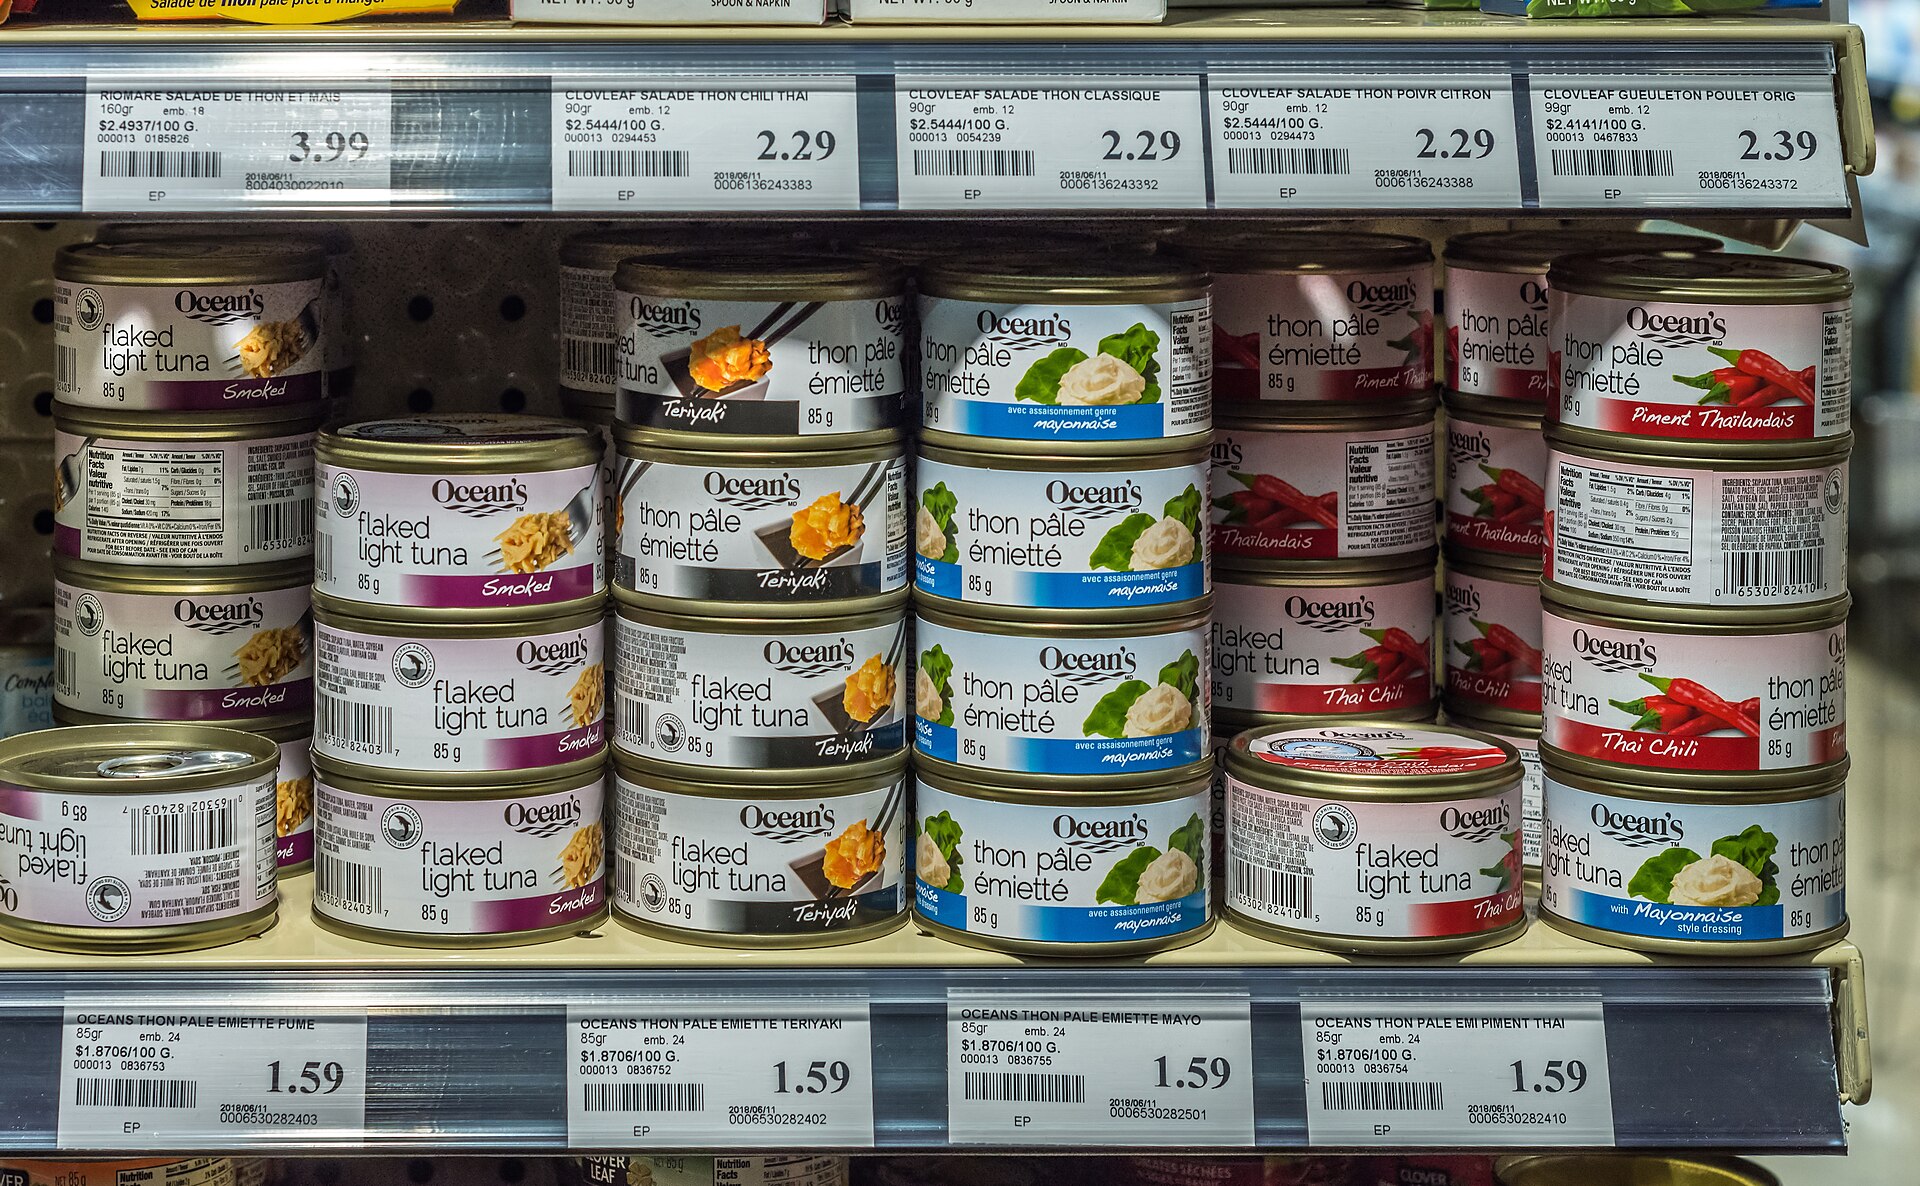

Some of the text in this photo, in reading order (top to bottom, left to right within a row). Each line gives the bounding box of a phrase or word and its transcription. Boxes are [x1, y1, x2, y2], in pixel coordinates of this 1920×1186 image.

[100, 91, 162, 100] RIOMARE
[166, 91, 220, 101] SALADE
[224, 91, 243, 101] DE
[246, 92, 284, 102] THON
[288, 92, 305, 101] ET
[565, 90, 808, 101] CLOVLEAF SALADE THON CHILI THAI
[909, 89, 1160, 101] CLOVLEAF SALADE THON CLASSIQUE
[1222, 89, 1491, 99] CLOVLEAF SALADE THON POIVR CITRON
[1544, 89, 1796, 101] CLOVLEAF GUEULETON POULET ORIG
[100, 120, 198, 131] $2.4937/100 G.
[566, 119, 664, 130] $2.5444/100 G.
[910, 119, 1009, 130] $2.5444/100 G.
[1224, 117, 1323, 128] $2.5444/100 G.
[1547, 119, 1645, 130] $2.4141/100 G.
[289, 132, 369, 163] 3.99
[757, 130, 835, 161] 2.29
[1102, 130, 1180, 161] 2.29
[1416, 129, 1494, 159] 2.29
[1739, 130, 1817, 161] 2.39
[714, 180, 812, 190] 0006136243383
[1375, 177, 1473, 188] 0006136243388
[1700, 179, 1797, 189] 0006136243372
[175, 288, 264, 312] Ocean's
[1347, 276, 1416, 304] Ocean's
[631, 296, 701, 330] Ocean's
[1627, 307, 1726, 337] Ocean's
[103, 323, 173, 348] flaked
[1268, 312, 1379, 342] thon pâle
[808, 338, 895, 370] thon pâle
[1269, 343, 1361, 365] émietté
[1564, 334, 1664, 369] thon pâle
[104, 349, 209, 376] light tuna
[103, 382, 124, 401] 85 g
[223, 380, 286, 399] Smoked
[809, 372, 884, 396] émietté
[1565, 367, 1640, 396] émietté
[663, 400, 727, 425] Teriyaki
[1632, 407, 1794, 428] Piment Thaïlandais
[432, 478, 527, 504] Ocean's
[1046, 479, 1142, 506] Ocean's
[358, 511, 429, 540] flaked
[969, 508, 1085, 542] thon pâle
[360, 539, 467, 568] light tuna
[969, 539, 1061, 567] émietté
[1593, 556, 1612, 565] REVERSE
[1616, 560, 1634, 568] VALEUR
[1635, 562, 1662, 572] NUTRITIVE
[359, 574, 379, 595] 85 g
[482, 576, 552, 596] Smoked
[969, 575, 991, 596] 85 g
[1103, 571, 1160, 582] assaisonnement
[1161, 571, 1177, 580] genre
[1108, 580, 1177, 600] mayonnaise
[1738, 582, 1815, 597] 65302 82410
[1285, 595, 1374, 620] Ocean's
[1324, 685, 1402, 705] Thai Chili
[740, 803, 835, 832] Ocean's
[1440, 798, 1510, 830] Ocean's
[672, 836, 747, 866] flaked
[1356, 843, 1438, 868] flaked
[673, 863, 786, 893] light tuna
[1358, 869, 1471, 900] light tuna
[1611, 902, 1742, 925] with Mayonnaise
[1678, 923, 1741, 935] style dressing
[76, 1014, 314, 1030] OCEANS THON PALE EMIETTE FUME
[580, 1018, 842, 1029] OCEANS THON PALE EMIETTE TERIYAKI
[961, 1009, 1202, 1026] OCEANS THON PALE EMIETTE MAYO
[1315, 1018, 1565, 1028] OCEANS THON PALE EMI PIMENT THAI
[76, 1045, 174, 1058] $1.8706/100 G.
[581, 1050, 679, 1063] $1.8706/100 G.
[962, 1039, 1060, 1053] $1.8706/100 G.
[1317, 1049, 1416, 1061] $1.8706/100 G.
[267, 1061, 343, 1094] 1.59
[773, 1061, 849, 1093] 1.59
[1154, 1056, 1230, 1089] 1.59
[1510, 1060, 1587, 1092] 1.59
[220, 1113, 317, 1125] 0006530282403
[729, 1114, 826, 1124] 0006530282402
[1110, 1108, 1206, 1120] 0006530282501
[1469, 1113, 1566, 1124] 0006530282410
[591, 1164, 616, 1184] LEAF
